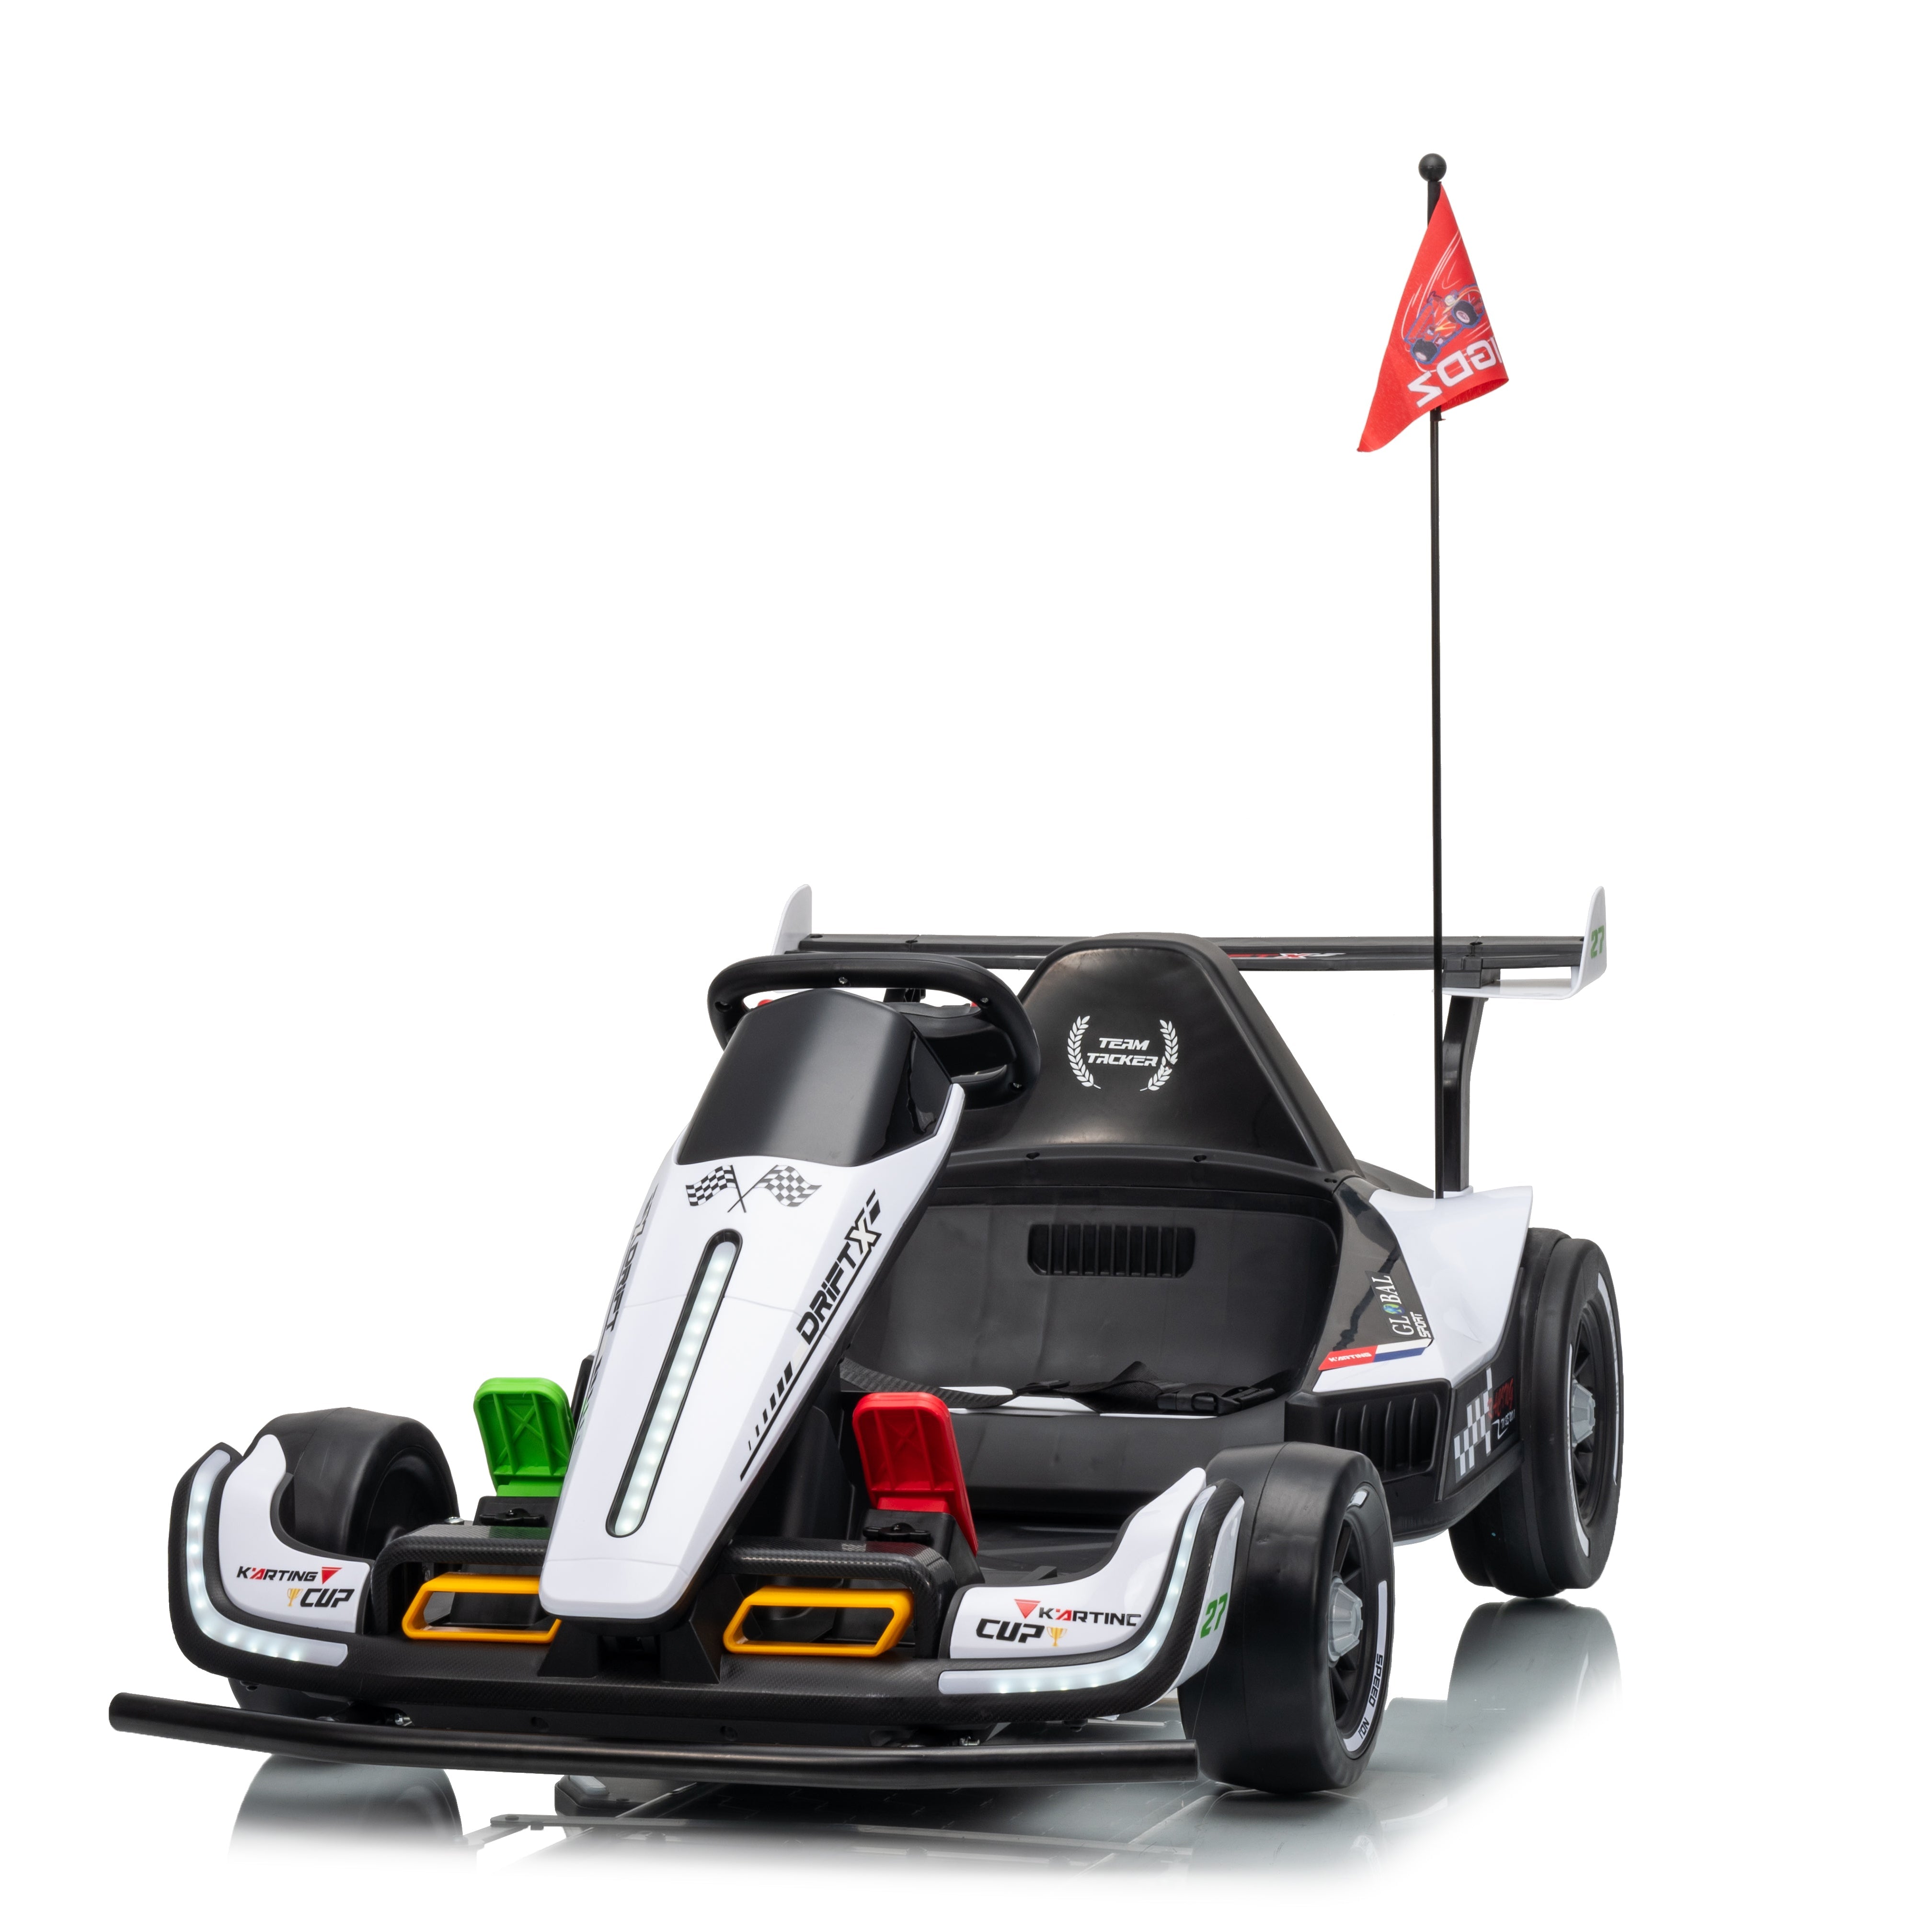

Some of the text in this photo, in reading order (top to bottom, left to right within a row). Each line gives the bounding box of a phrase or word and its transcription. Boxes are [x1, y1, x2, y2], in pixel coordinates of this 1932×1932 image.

[1590, 925, 1604, 959] 27
[1099, 1037, 1150, 1050] TEAM
[1087, 1053, 1158, 1067] TACKER
[1410, 1311, 1431, 1338] SPORT
[300, 1588, 355, 1608] CUP
[1200, 1592, 1228, 1639] 27
[976, 1618, 1045, 1643] CUP
[1368, 1654, 1383, 1708] SPEED
